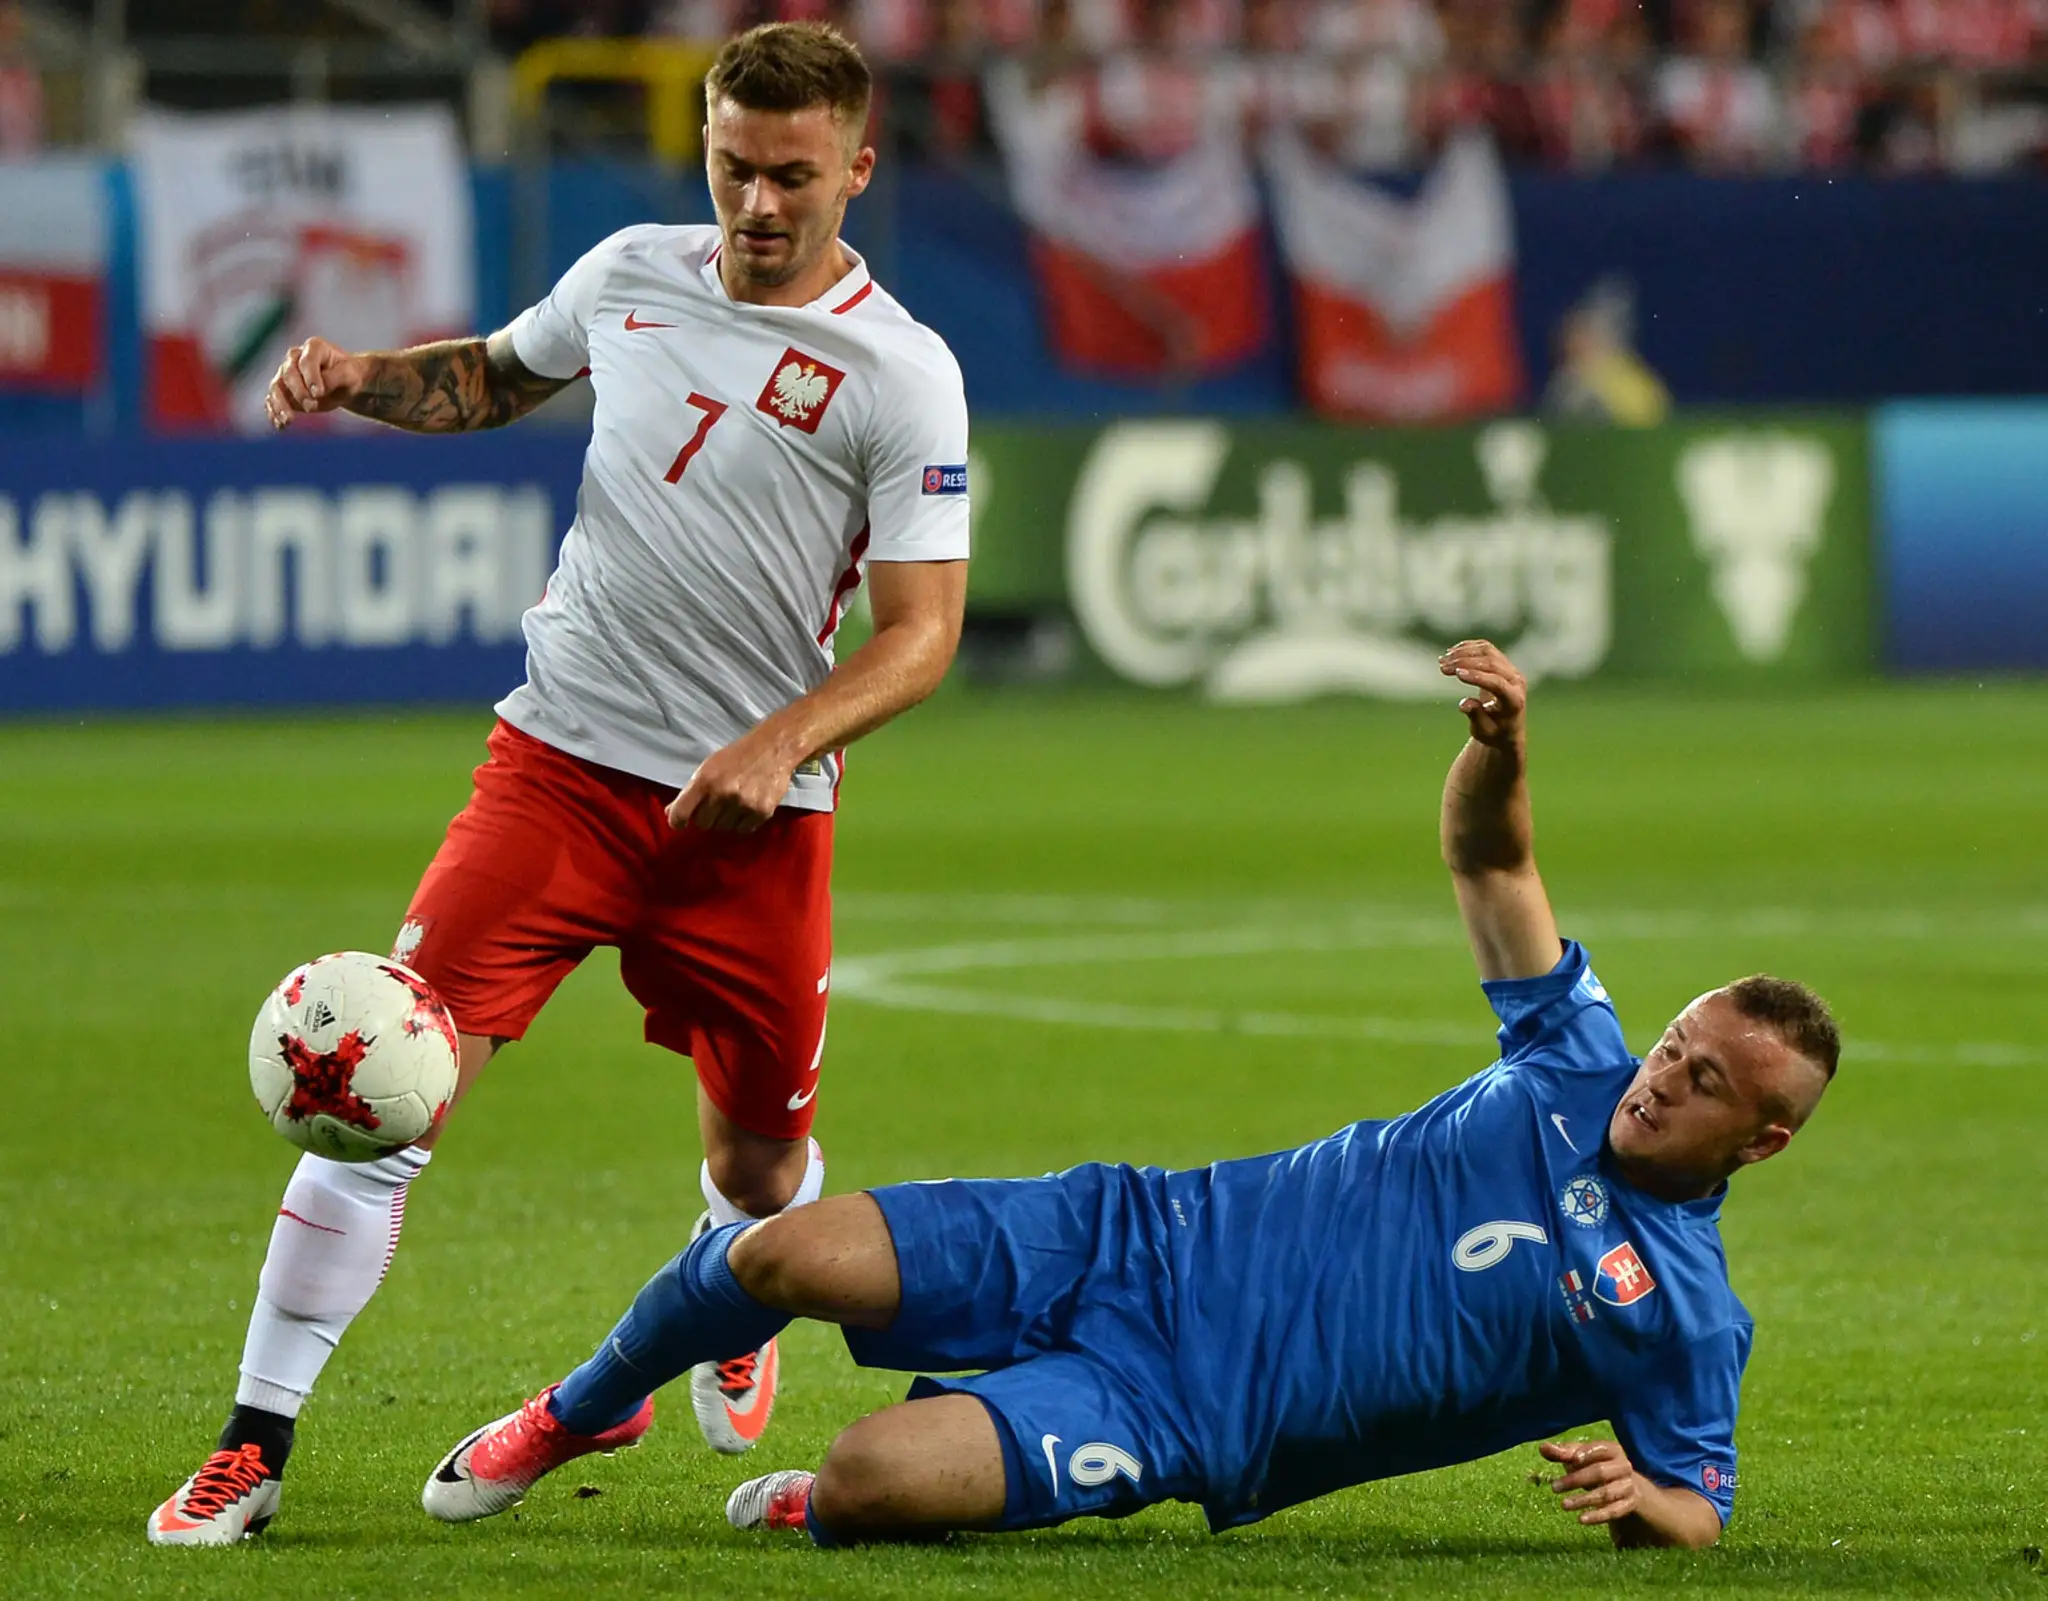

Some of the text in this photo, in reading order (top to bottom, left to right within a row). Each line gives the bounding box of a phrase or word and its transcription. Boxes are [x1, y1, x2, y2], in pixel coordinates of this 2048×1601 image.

[662, 391, 729, 485] 7
[0, 485, 552, 654] HYUNDAI
[1067, 421, 1612, 684] Carlsberg
[1451, 1220, 1548, 1272] 6
[1068, 1442, 1143, 1487] 6
